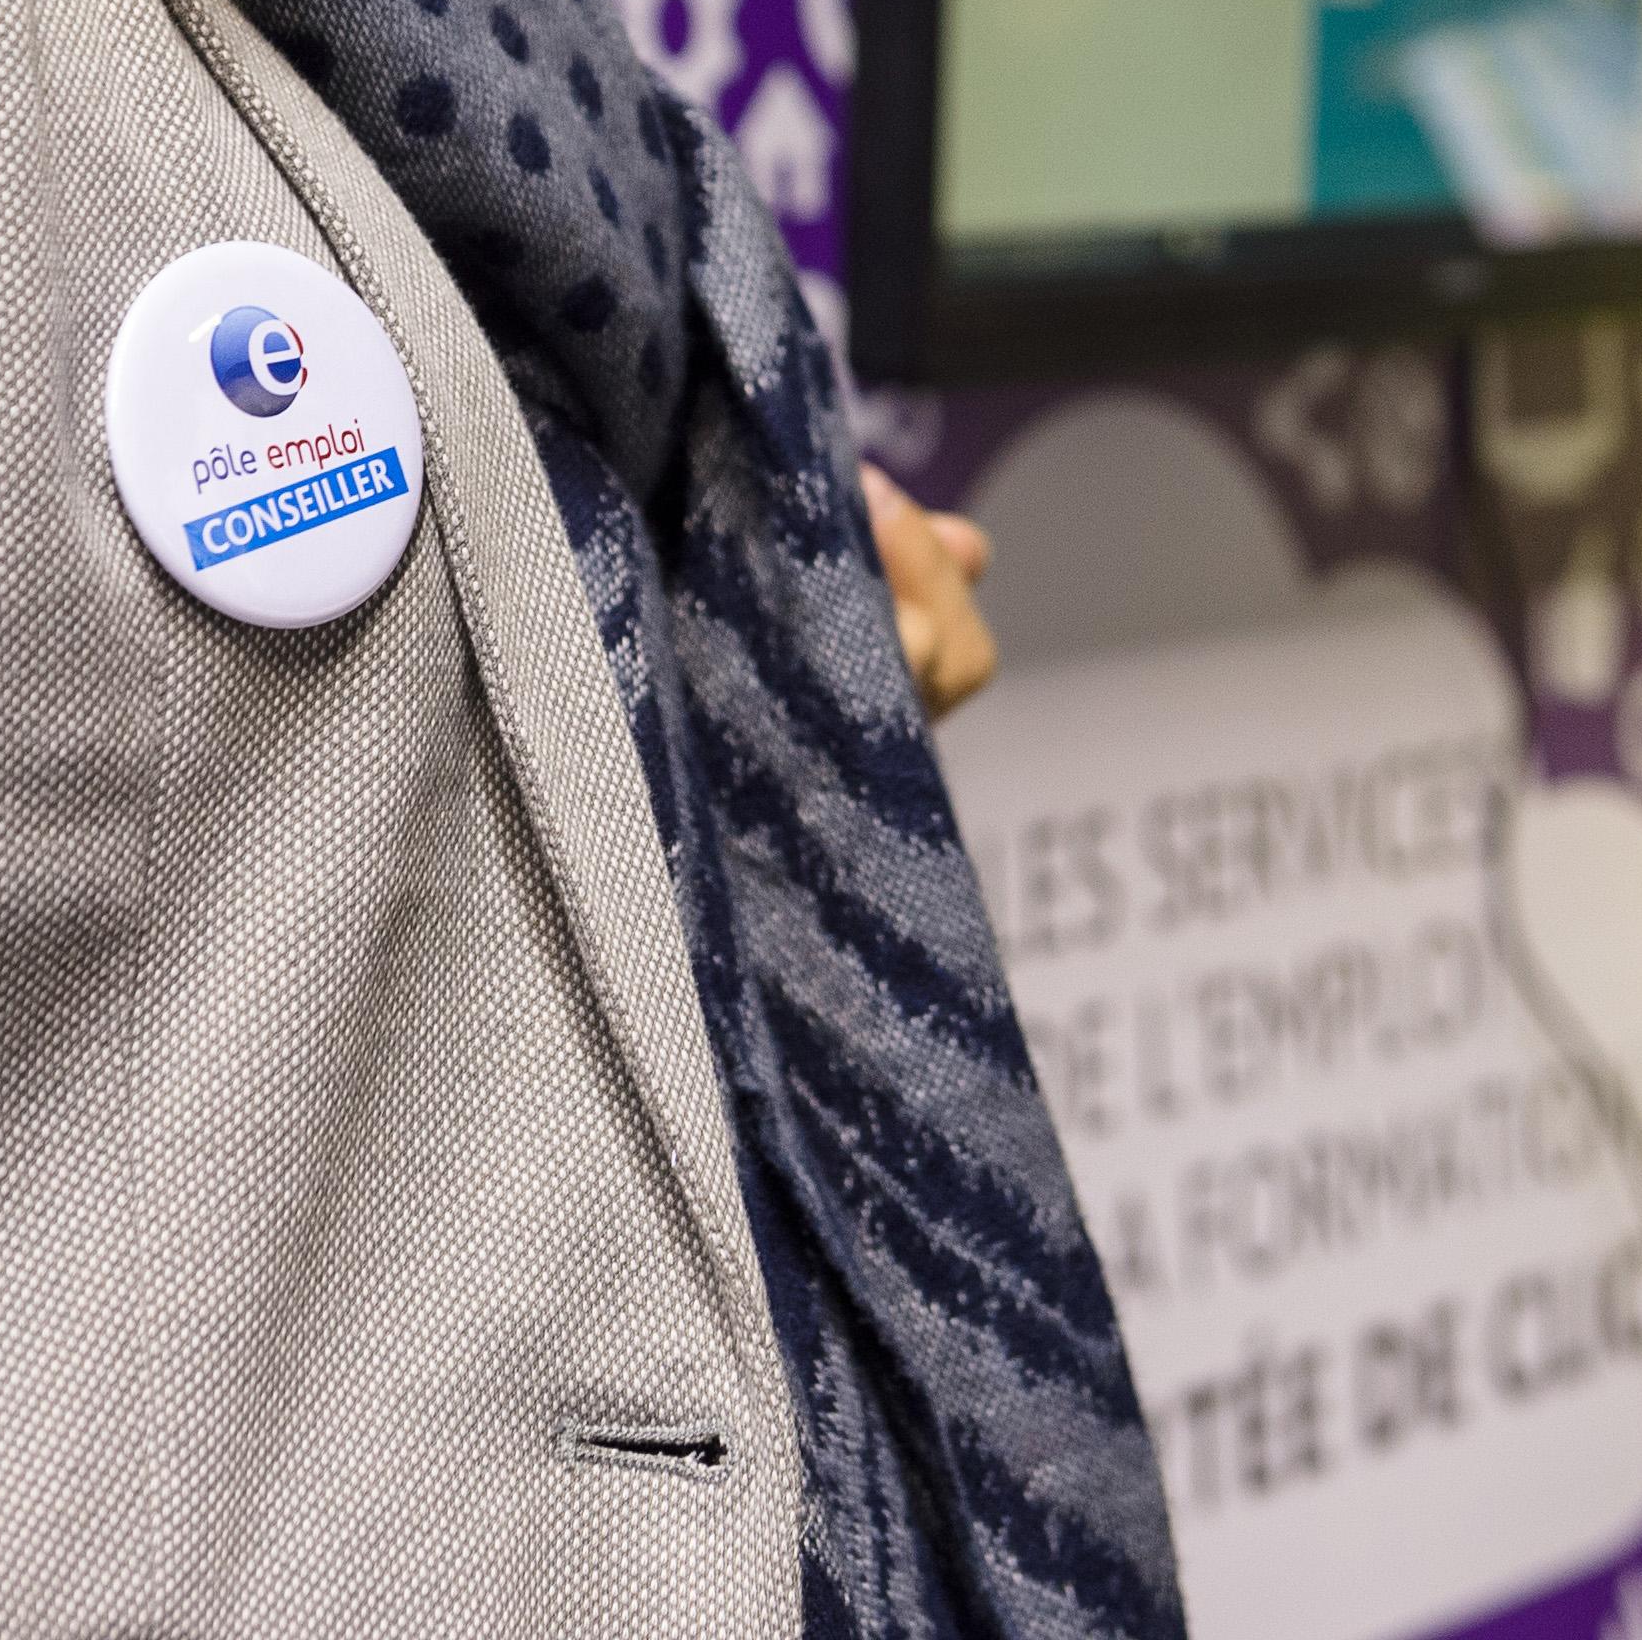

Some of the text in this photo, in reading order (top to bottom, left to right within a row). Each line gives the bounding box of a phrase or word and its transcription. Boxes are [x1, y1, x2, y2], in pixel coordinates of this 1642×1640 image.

[192, 418, 366, 495] pôle emploi
[201, 457, 395, 555] CONSEILLER
